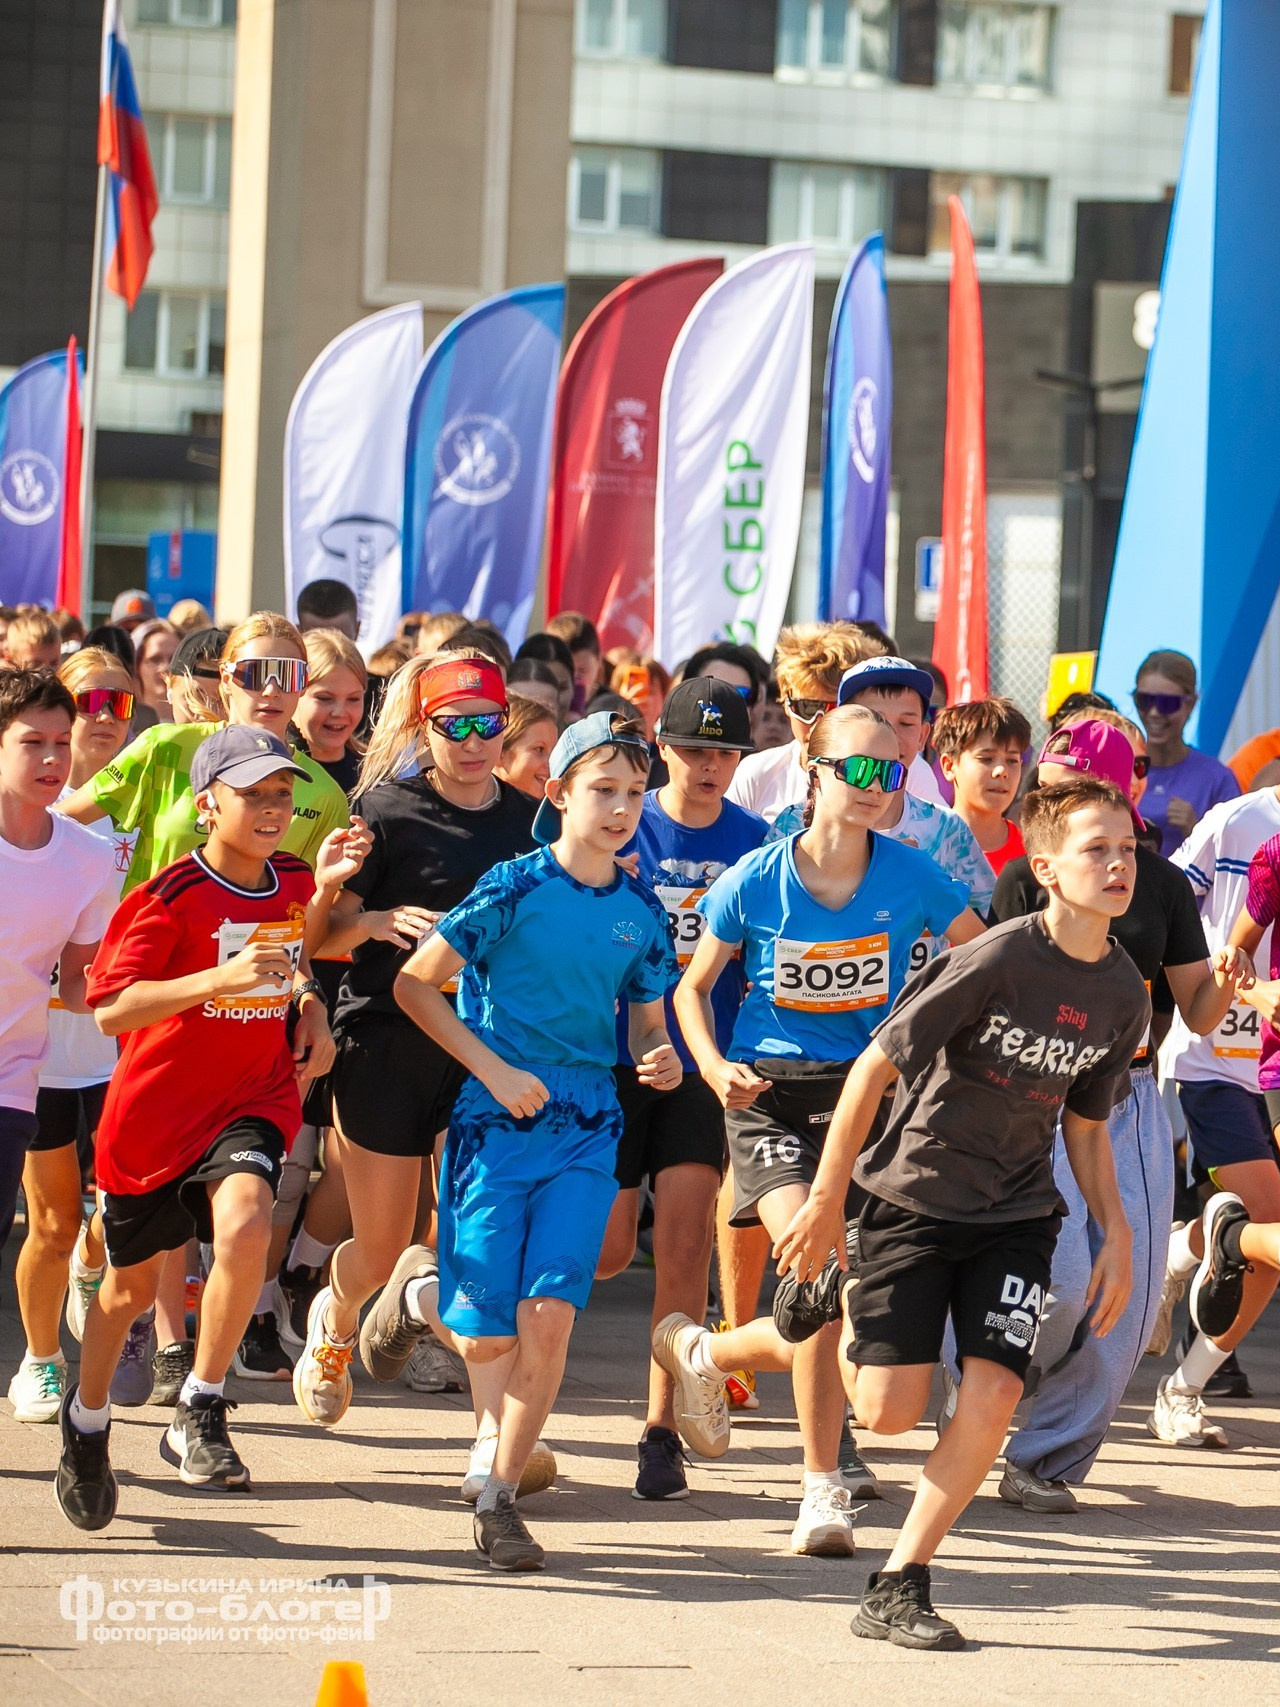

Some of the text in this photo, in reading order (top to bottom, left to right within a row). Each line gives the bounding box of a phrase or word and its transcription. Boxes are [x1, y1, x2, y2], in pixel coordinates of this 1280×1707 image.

[723, 440, 764, 597] СБЕР
[698, 726, 723, 736] JUDO
[780, 957, 884, 991] 3092
[1057, 1004, 1088, 1031] Slay
[754, 1134, 801, 1168] 16
